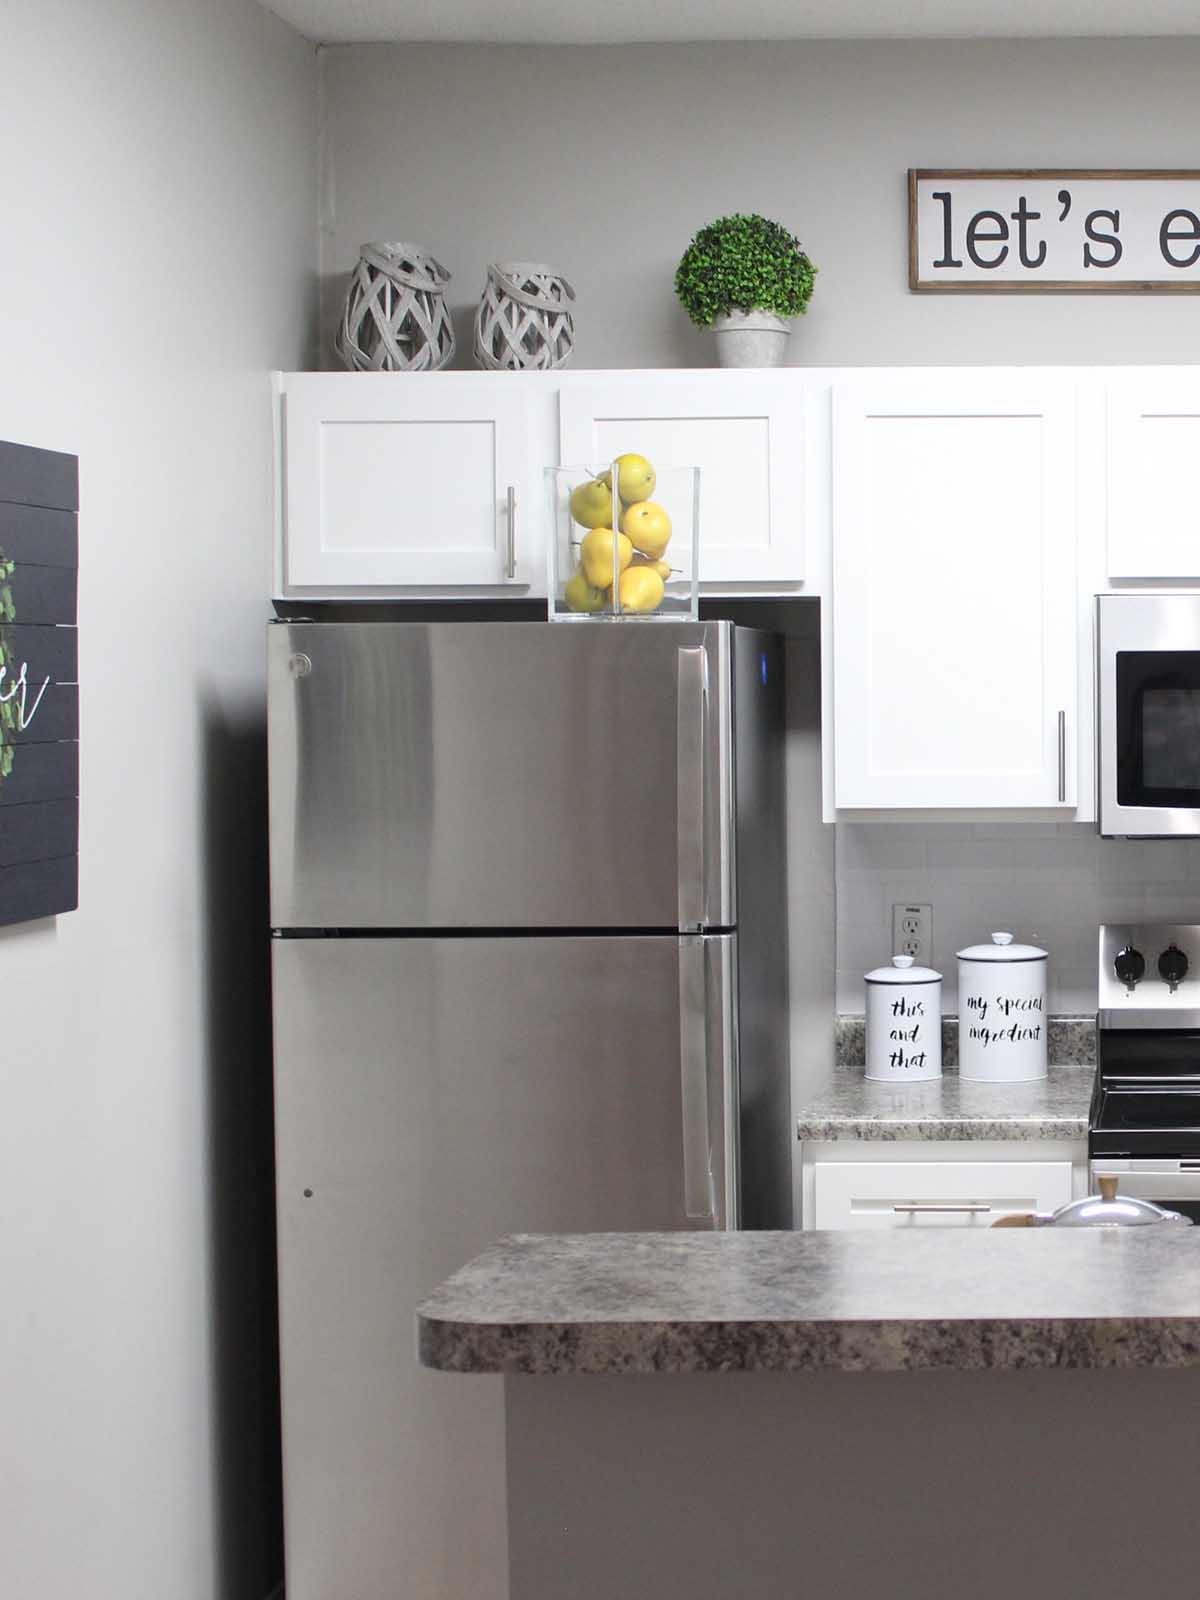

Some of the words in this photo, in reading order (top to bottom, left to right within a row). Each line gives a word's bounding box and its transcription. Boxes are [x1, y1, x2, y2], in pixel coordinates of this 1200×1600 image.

[932, 190, 1123, 269] let's
[891, 996, 924, 1017] this
[967, 996, 988, 1020] my
[996, 993, 1043, 1015] special
[889, 1024, 920, 1042] and
[969, 1023, 1040, 1048] ingredient
[889, 1047, 928, 1068] that
